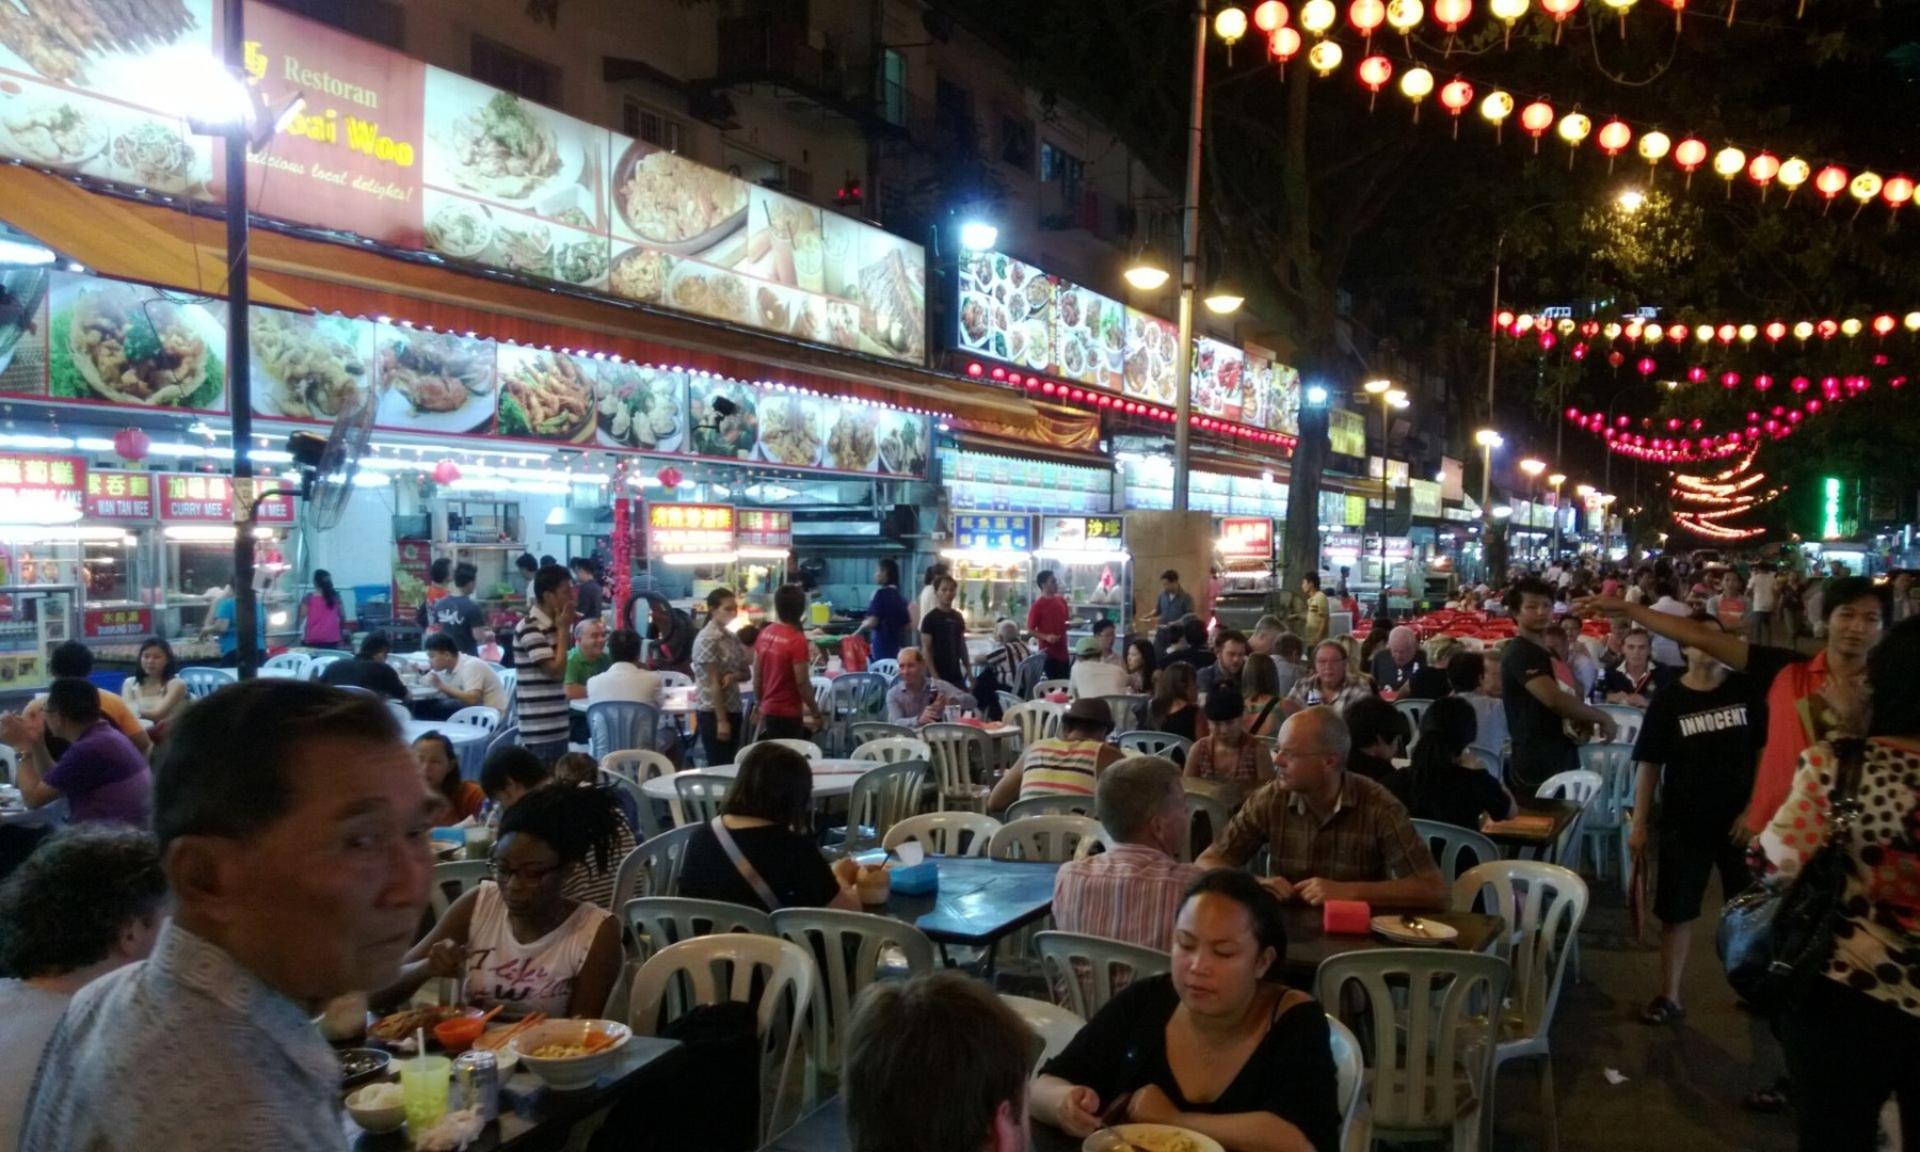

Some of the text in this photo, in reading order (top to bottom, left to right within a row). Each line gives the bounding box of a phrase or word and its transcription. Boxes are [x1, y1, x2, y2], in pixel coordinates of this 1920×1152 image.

[283, 54, 379, 109] Restoran
[344, 113, 415, 168] Woo
[246, 152, 413, 203] elicious local delights!
[97, 500, 149, 517] WAN TAN MEE
[170, 502, 223, 516] CURRY MEE
[267, 503, 288, 517] MEE
[1680, 707, 1748, 737] INNOCENT
